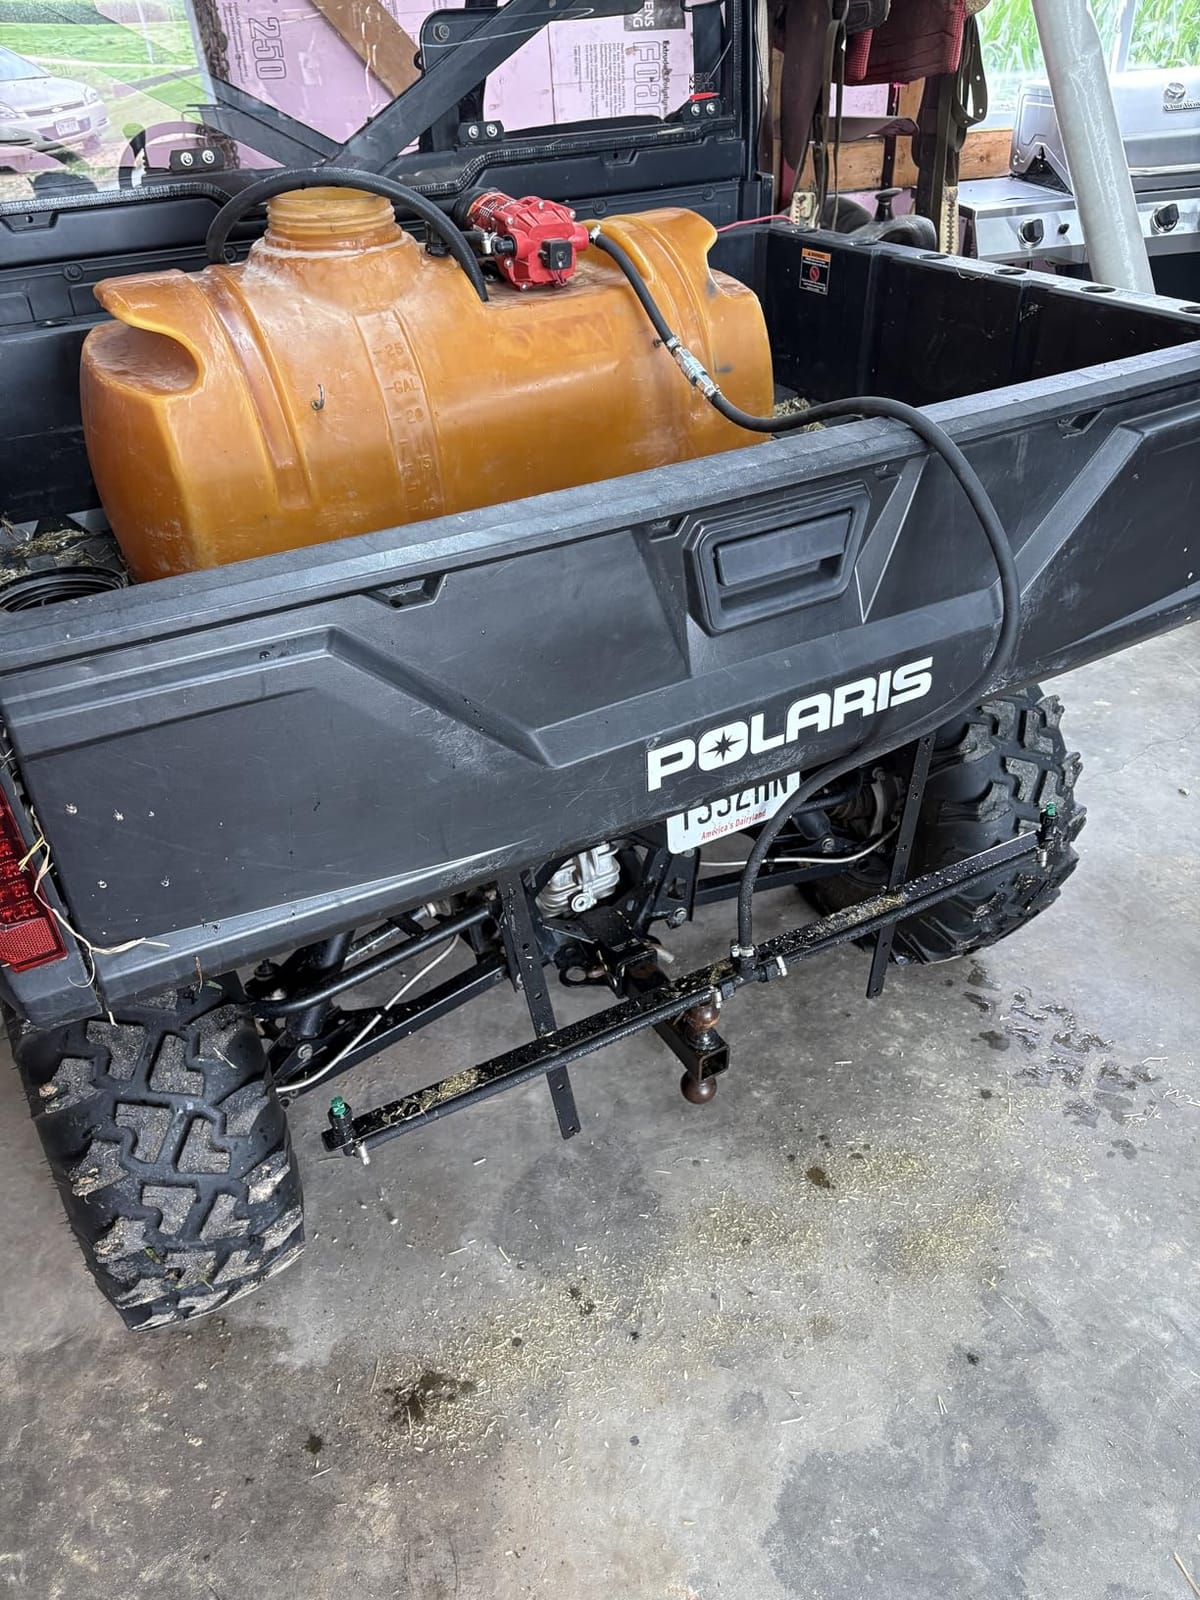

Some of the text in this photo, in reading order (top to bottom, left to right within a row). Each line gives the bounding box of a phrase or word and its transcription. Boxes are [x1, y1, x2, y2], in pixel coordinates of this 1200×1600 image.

[248, 17, 287, 80] 250
[385, 342, 404, 358] 25
[393, 378, 421, 394] GAL
[406, 407, 425, 424] 20
[647, 656, 933, 792] POLARIS
[701, 808, 767, 841] America's Dairyland
